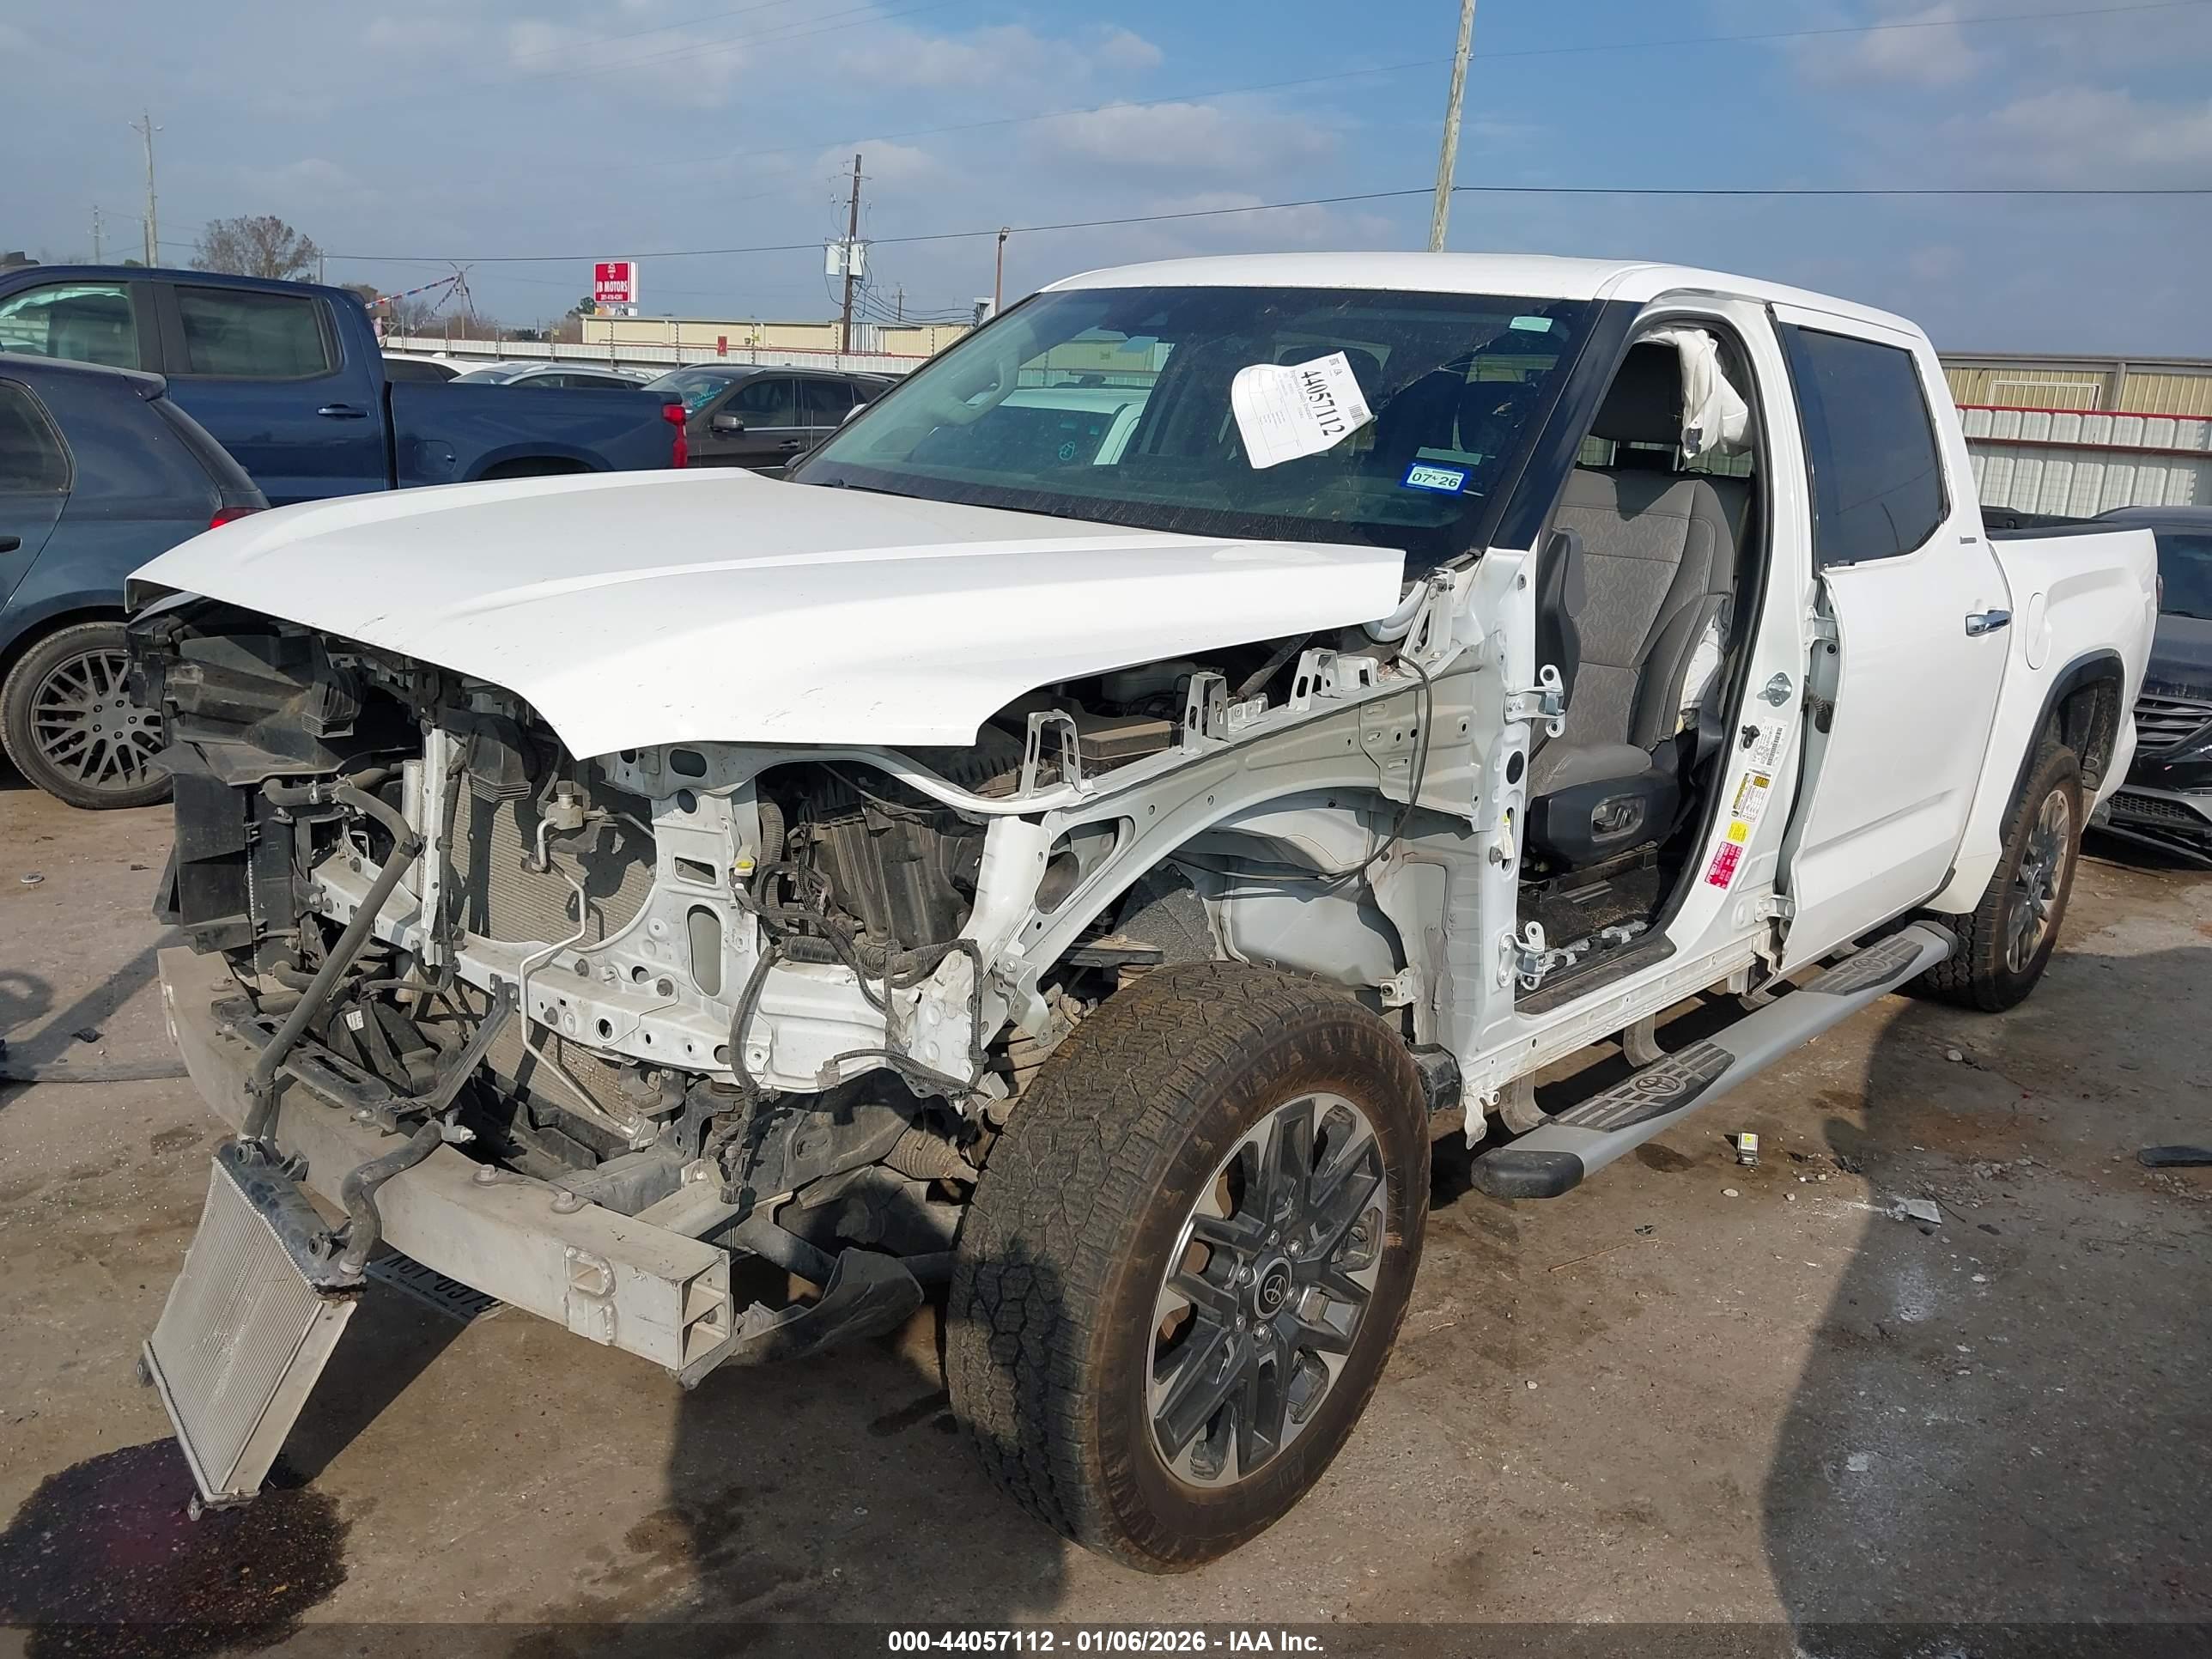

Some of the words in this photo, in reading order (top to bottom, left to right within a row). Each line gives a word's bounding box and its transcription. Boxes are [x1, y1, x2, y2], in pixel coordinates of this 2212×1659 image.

[596, 281, 604, 293] JB
[604, 280, 628, 293] MOTORS
[1300, 370, 1346, 437] 44057112
[1412, 472, 1432, 483] 07
[1437, 477, 1459, 487] 26
